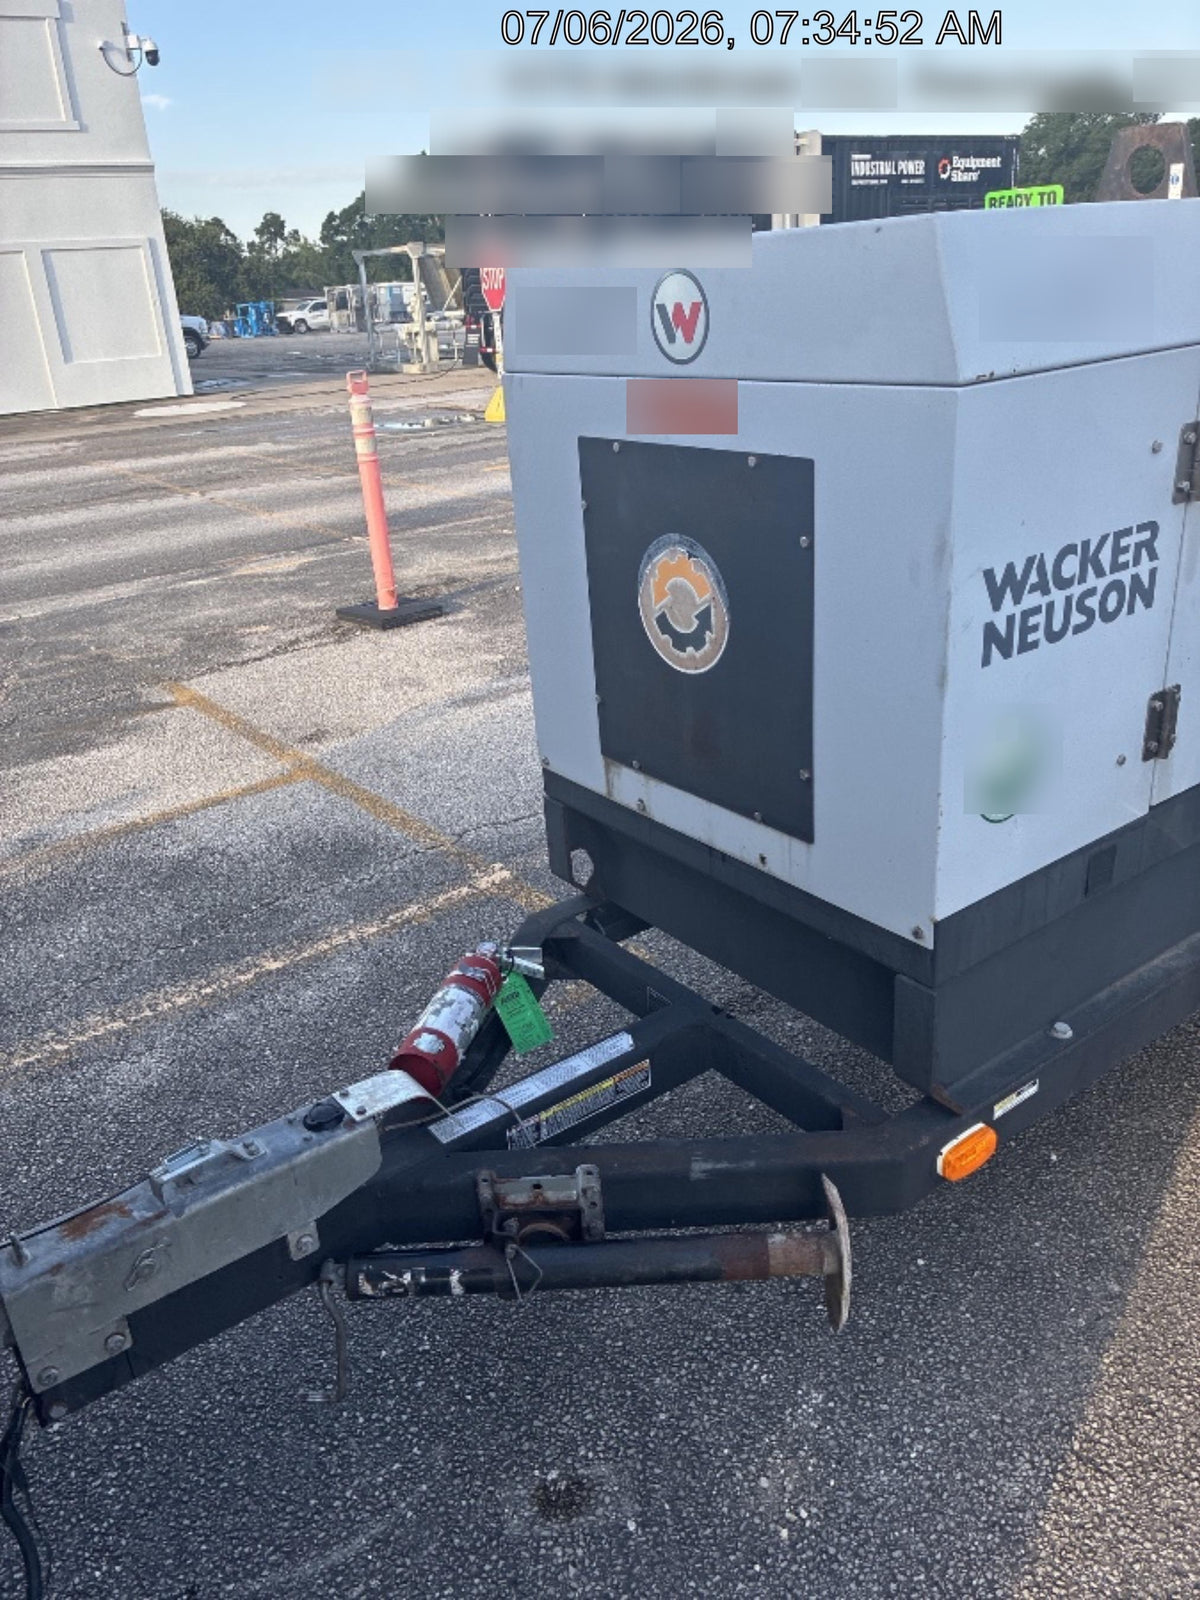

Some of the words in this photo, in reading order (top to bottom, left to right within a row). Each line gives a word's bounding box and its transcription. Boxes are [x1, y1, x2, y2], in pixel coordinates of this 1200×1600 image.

[851, 160, 897, 176] INDUSTRIAL
[897, 159, 926, 175] POWER
[952, 155, 1002, 170] Equipment
[989, 192, 1034, 209] READY
[482, 267, 504, 290] STOP
[982, 520, 1160, 612] WACKER
[981, 567, 1158, 669] NEUSON
